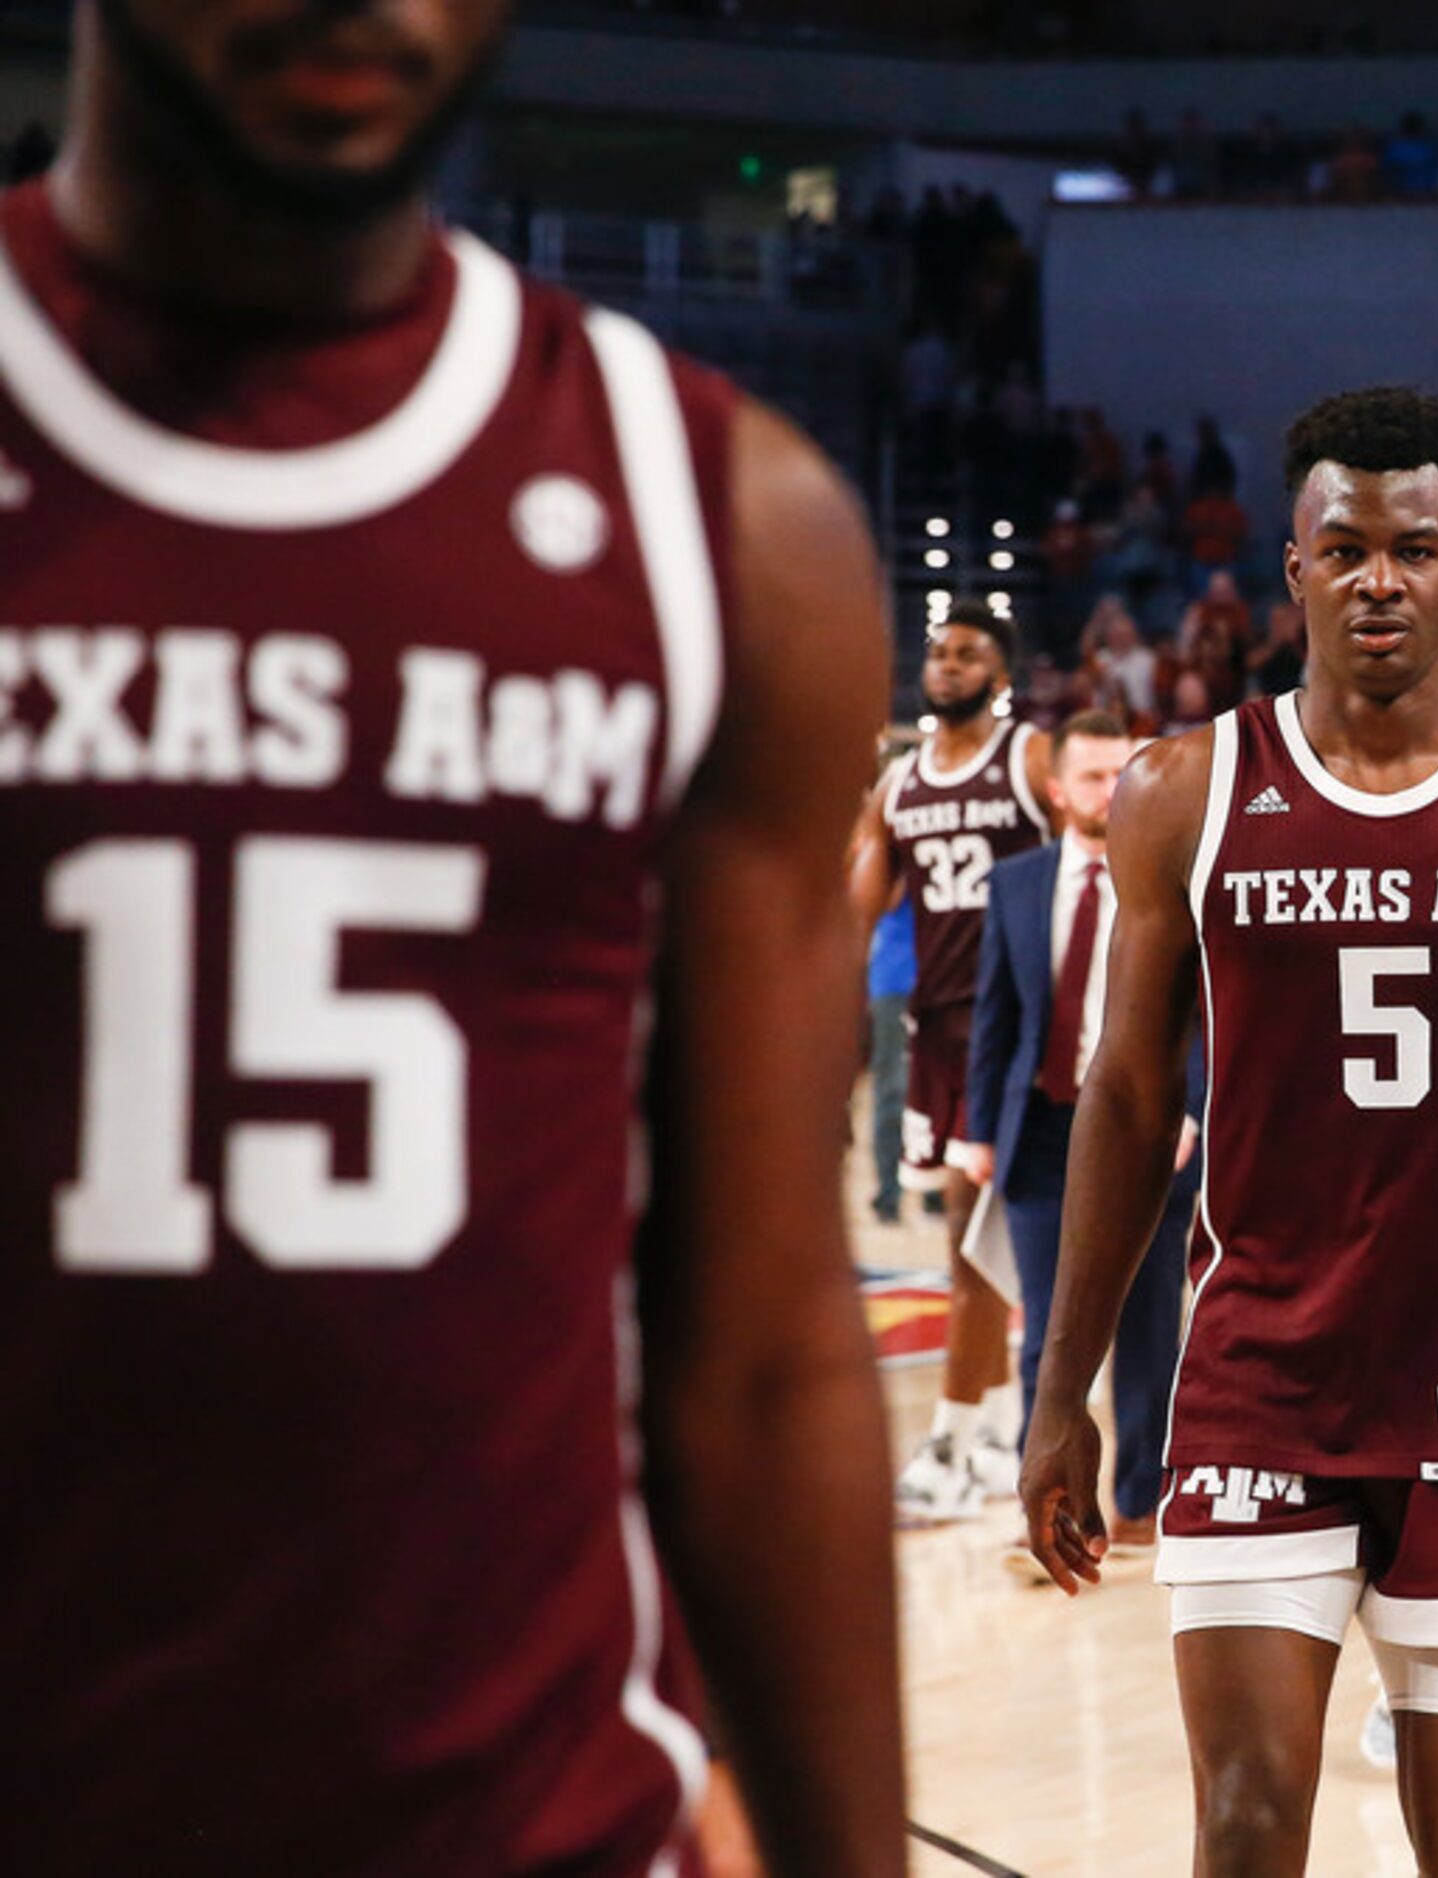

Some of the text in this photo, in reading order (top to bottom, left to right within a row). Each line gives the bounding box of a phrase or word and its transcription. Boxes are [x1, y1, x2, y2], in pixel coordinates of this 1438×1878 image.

[385, 645, 658, 830] A&M
[913, 833, 993, 913] 32
[1223, 868, 1411, 925] TEXAS
[45, 835, 487, 1275] 15
[1338, 946, 1430, 1109] 5
